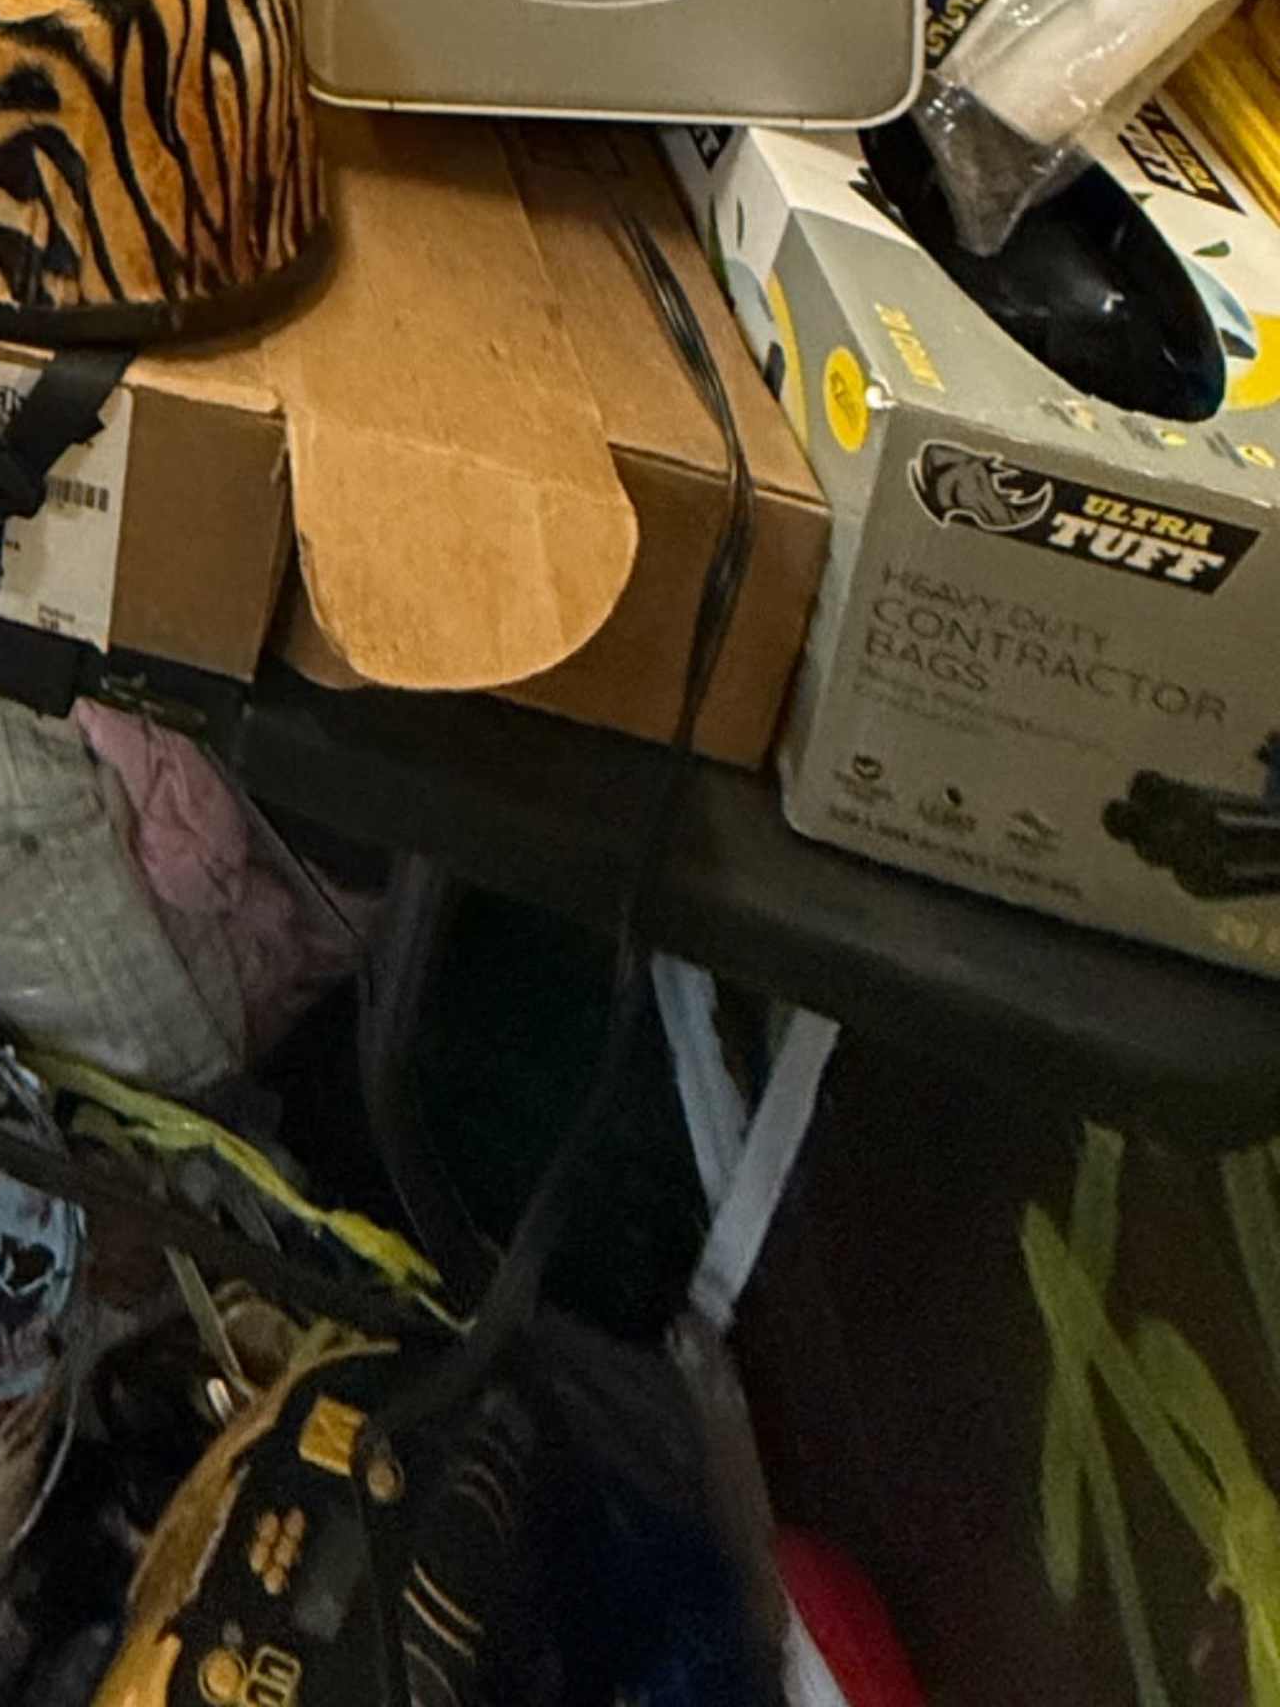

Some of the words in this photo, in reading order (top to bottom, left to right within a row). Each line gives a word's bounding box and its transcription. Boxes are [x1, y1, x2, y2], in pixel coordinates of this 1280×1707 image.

[1047, 513, 1226, 582] TUFF
[1081, 493, 1214, 546] ULTRA
[881, 561, 992, 620] HEAVY
[1008, 606, 1112, 655] DUTY
[865, 627, 990, 693] BAGS
[872, 596, 1229, 725] CONTRACTOR
